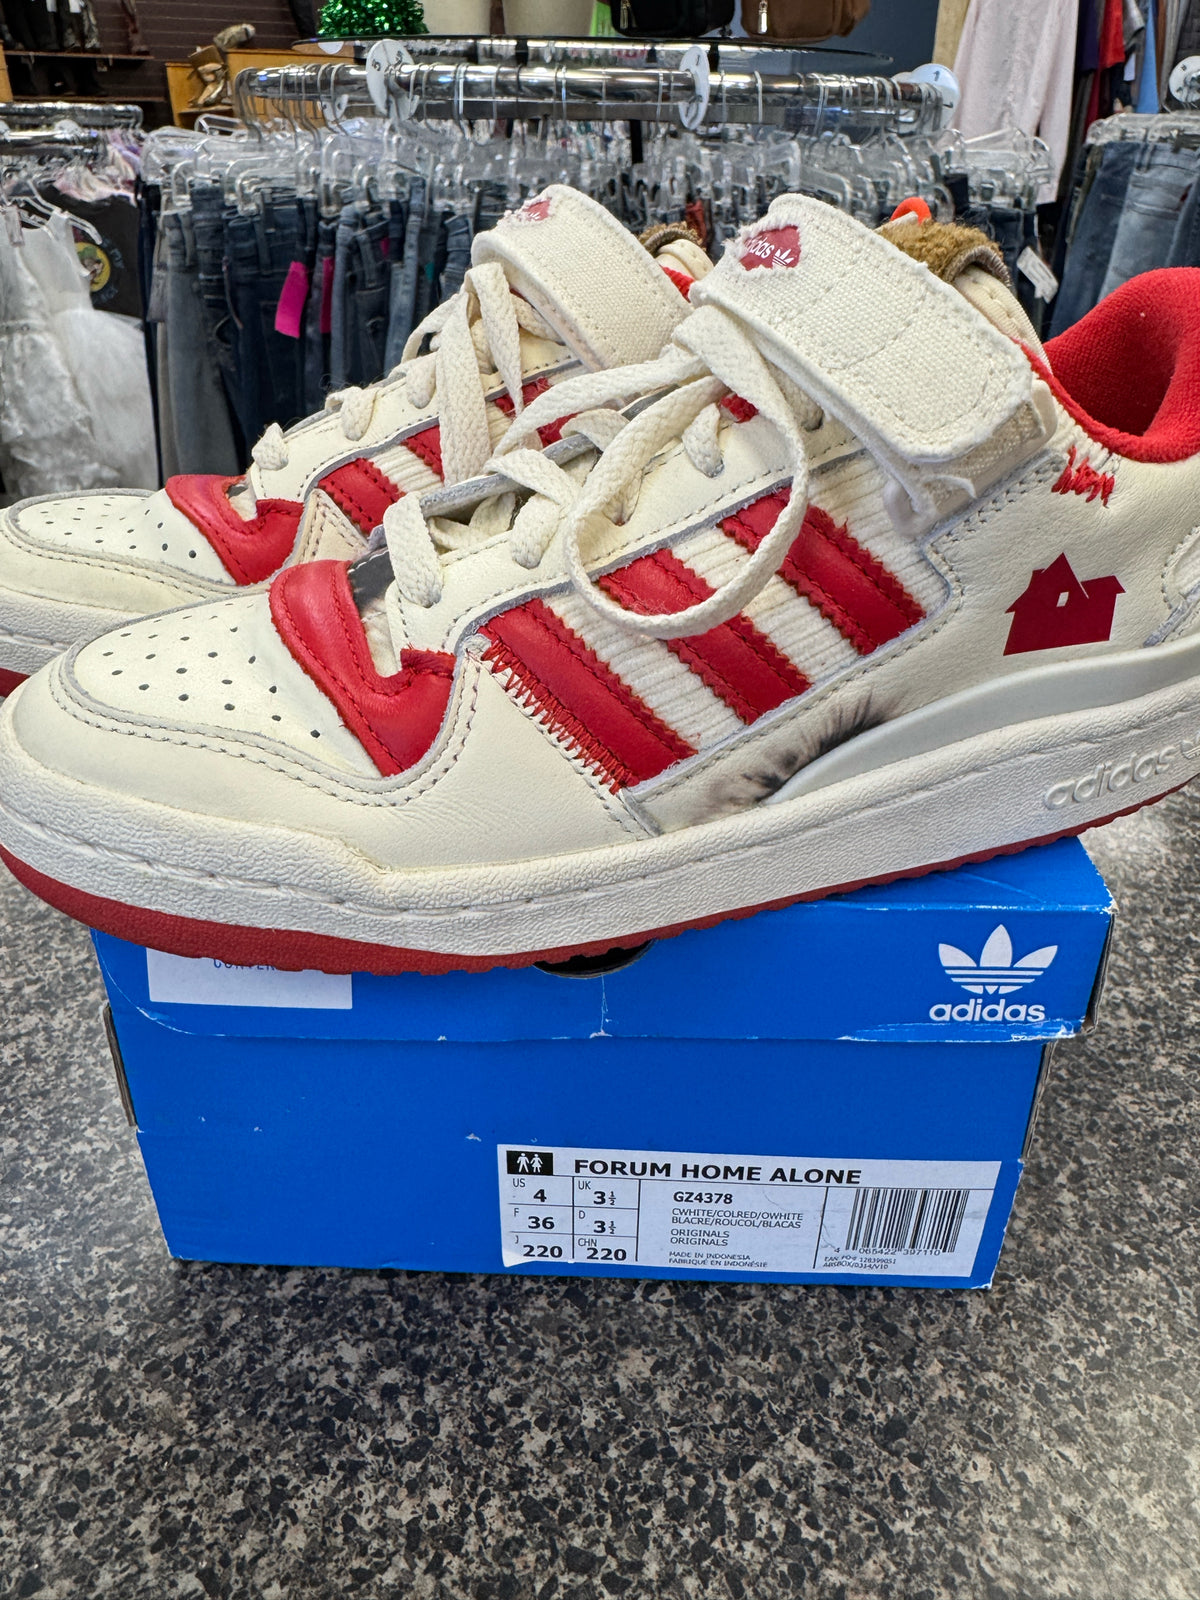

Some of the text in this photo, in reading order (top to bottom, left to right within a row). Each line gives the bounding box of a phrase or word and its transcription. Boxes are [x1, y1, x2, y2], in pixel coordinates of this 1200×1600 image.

[1045, 746, 1177, 810] adidas
[929, 998, 1046, 1022] adidas
[574, 1159, 862, 1185] FORUM HOME ALONE
[512, 1178, 526, 1188] US
[577, 1180, 592, 1191] UK
[533, 1188, 547, 1203] 4
[673, 1191, 733, 1205] GZ4378
[513, 1208, 520, 1218] F
[578, 1210, 586, 1220] D
[671, 1207, 804, 1221] CWHITE/COLRED/OWHITE
[527, 1216, 555, 1230] 36
[671, 1216, 802, 1229] BLACRE/ROUCOL/BLACAS
[670, 1228, 730, 1238] ORIGINALS
[577, 1237, 598, 1248] CHN
[670, 1237, 728, 1247] ORIGINALS
[522, 1244, 563, 1258] 220
[586, 1247, 627, 1261] 220
[669, 1250, 691, 1258] MADE
[706, 1252, 751, 1261] INDONESIA
[858, 1247, 898, 1256] 065422
[903, 1248, 941, 1257] 397110
